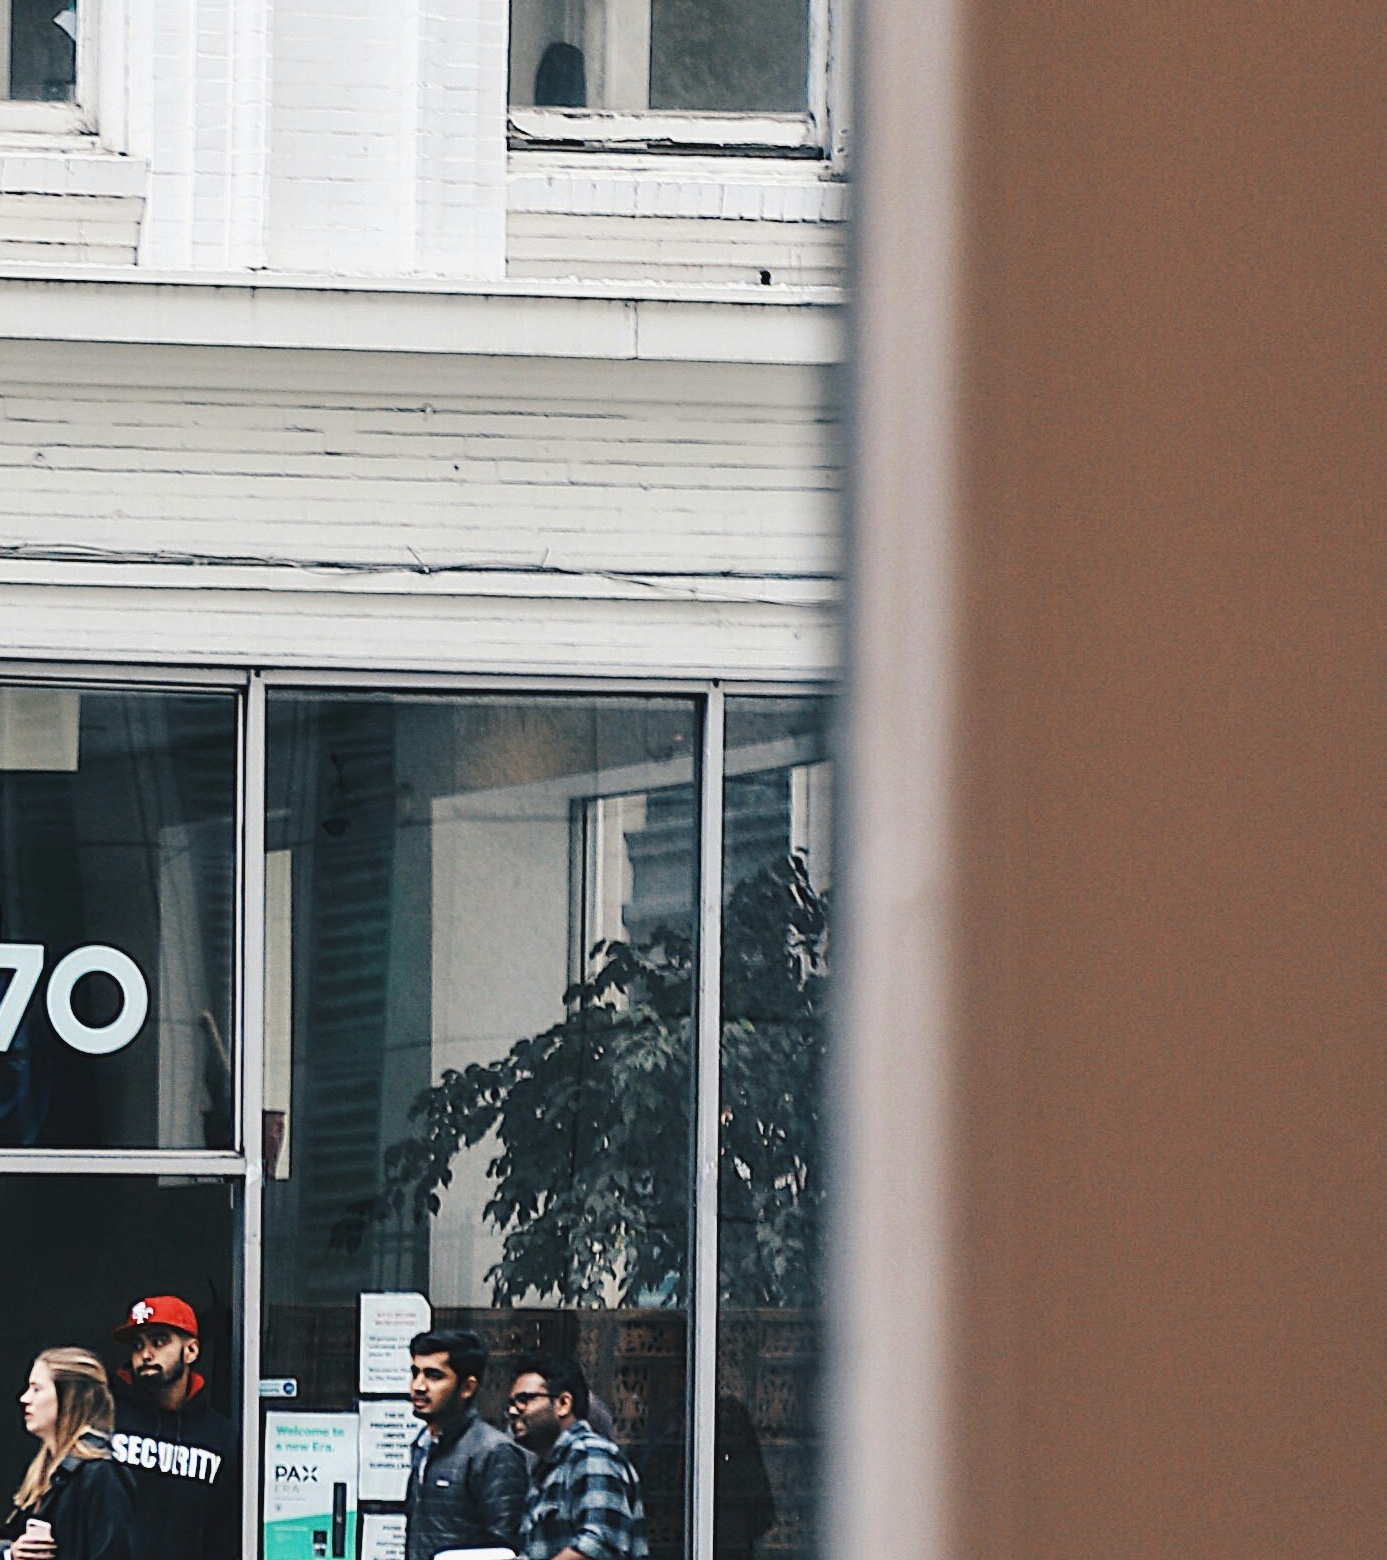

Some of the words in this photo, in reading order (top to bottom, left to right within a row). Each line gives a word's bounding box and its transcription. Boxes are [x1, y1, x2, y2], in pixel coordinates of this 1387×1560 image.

[276, 1425, 329, 1437] Welcome
[332, 1426, 344, 1437] to
[111, 1433, 222, 1484] SECURITY
[275, 1466, 318, 1482] PAX
